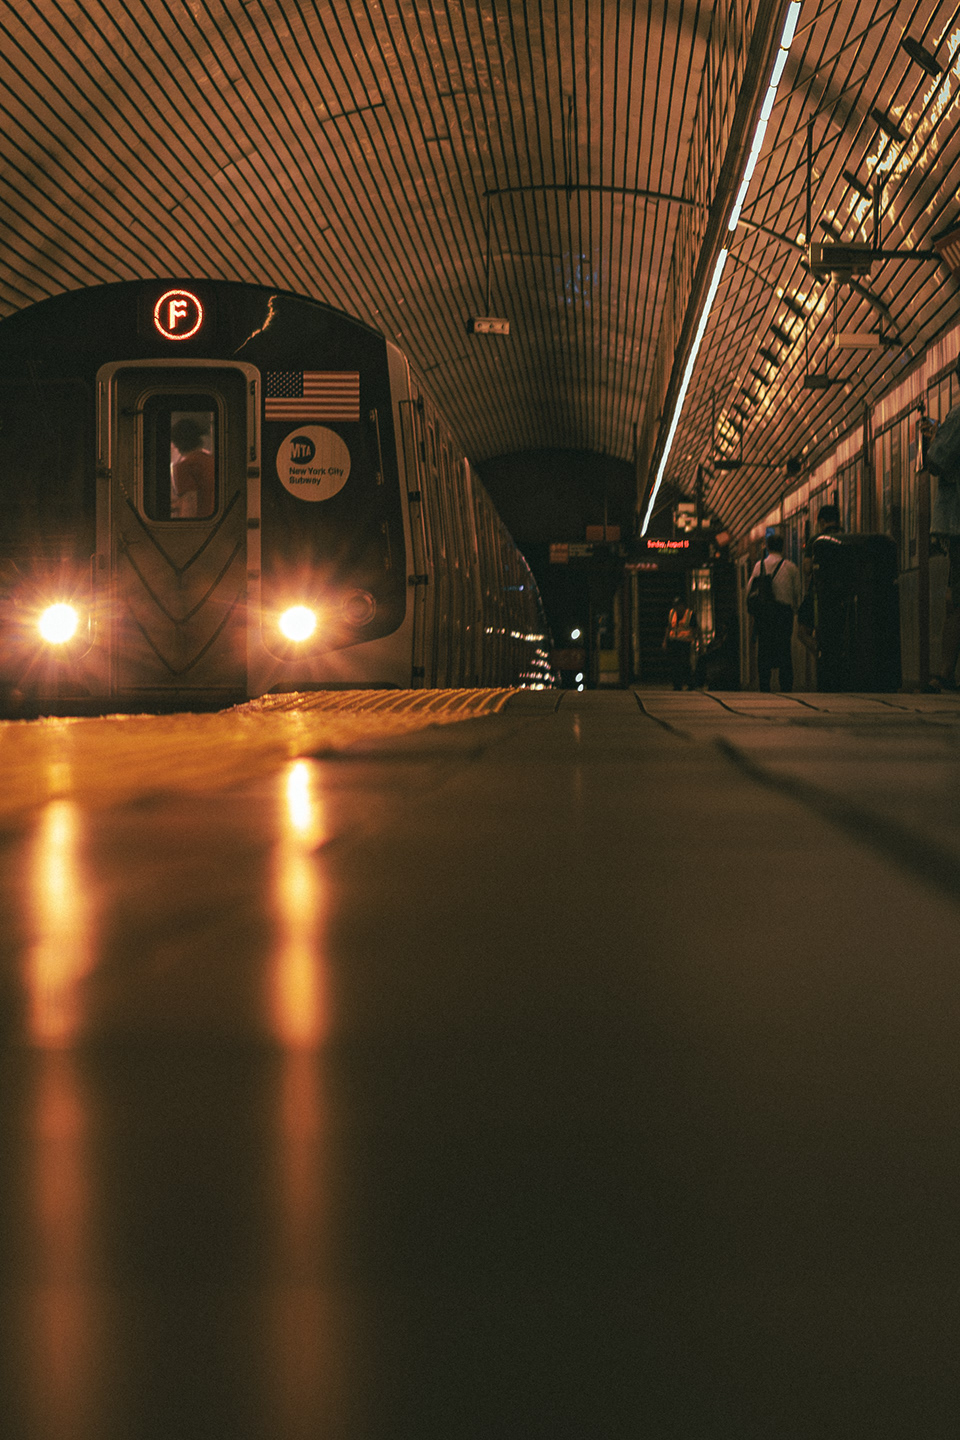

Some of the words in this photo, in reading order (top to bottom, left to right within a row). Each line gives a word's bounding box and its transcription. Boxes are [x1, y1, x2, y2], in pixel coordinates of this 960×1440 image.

[169, 299, 188, 330] F
[290, 442, 312, 459] MTA
[289, 467, 307, 475] New
[308, 467, 327, 475] York
[327, 467, 344, 477] City
[289, 476, 322, 486] Subway
